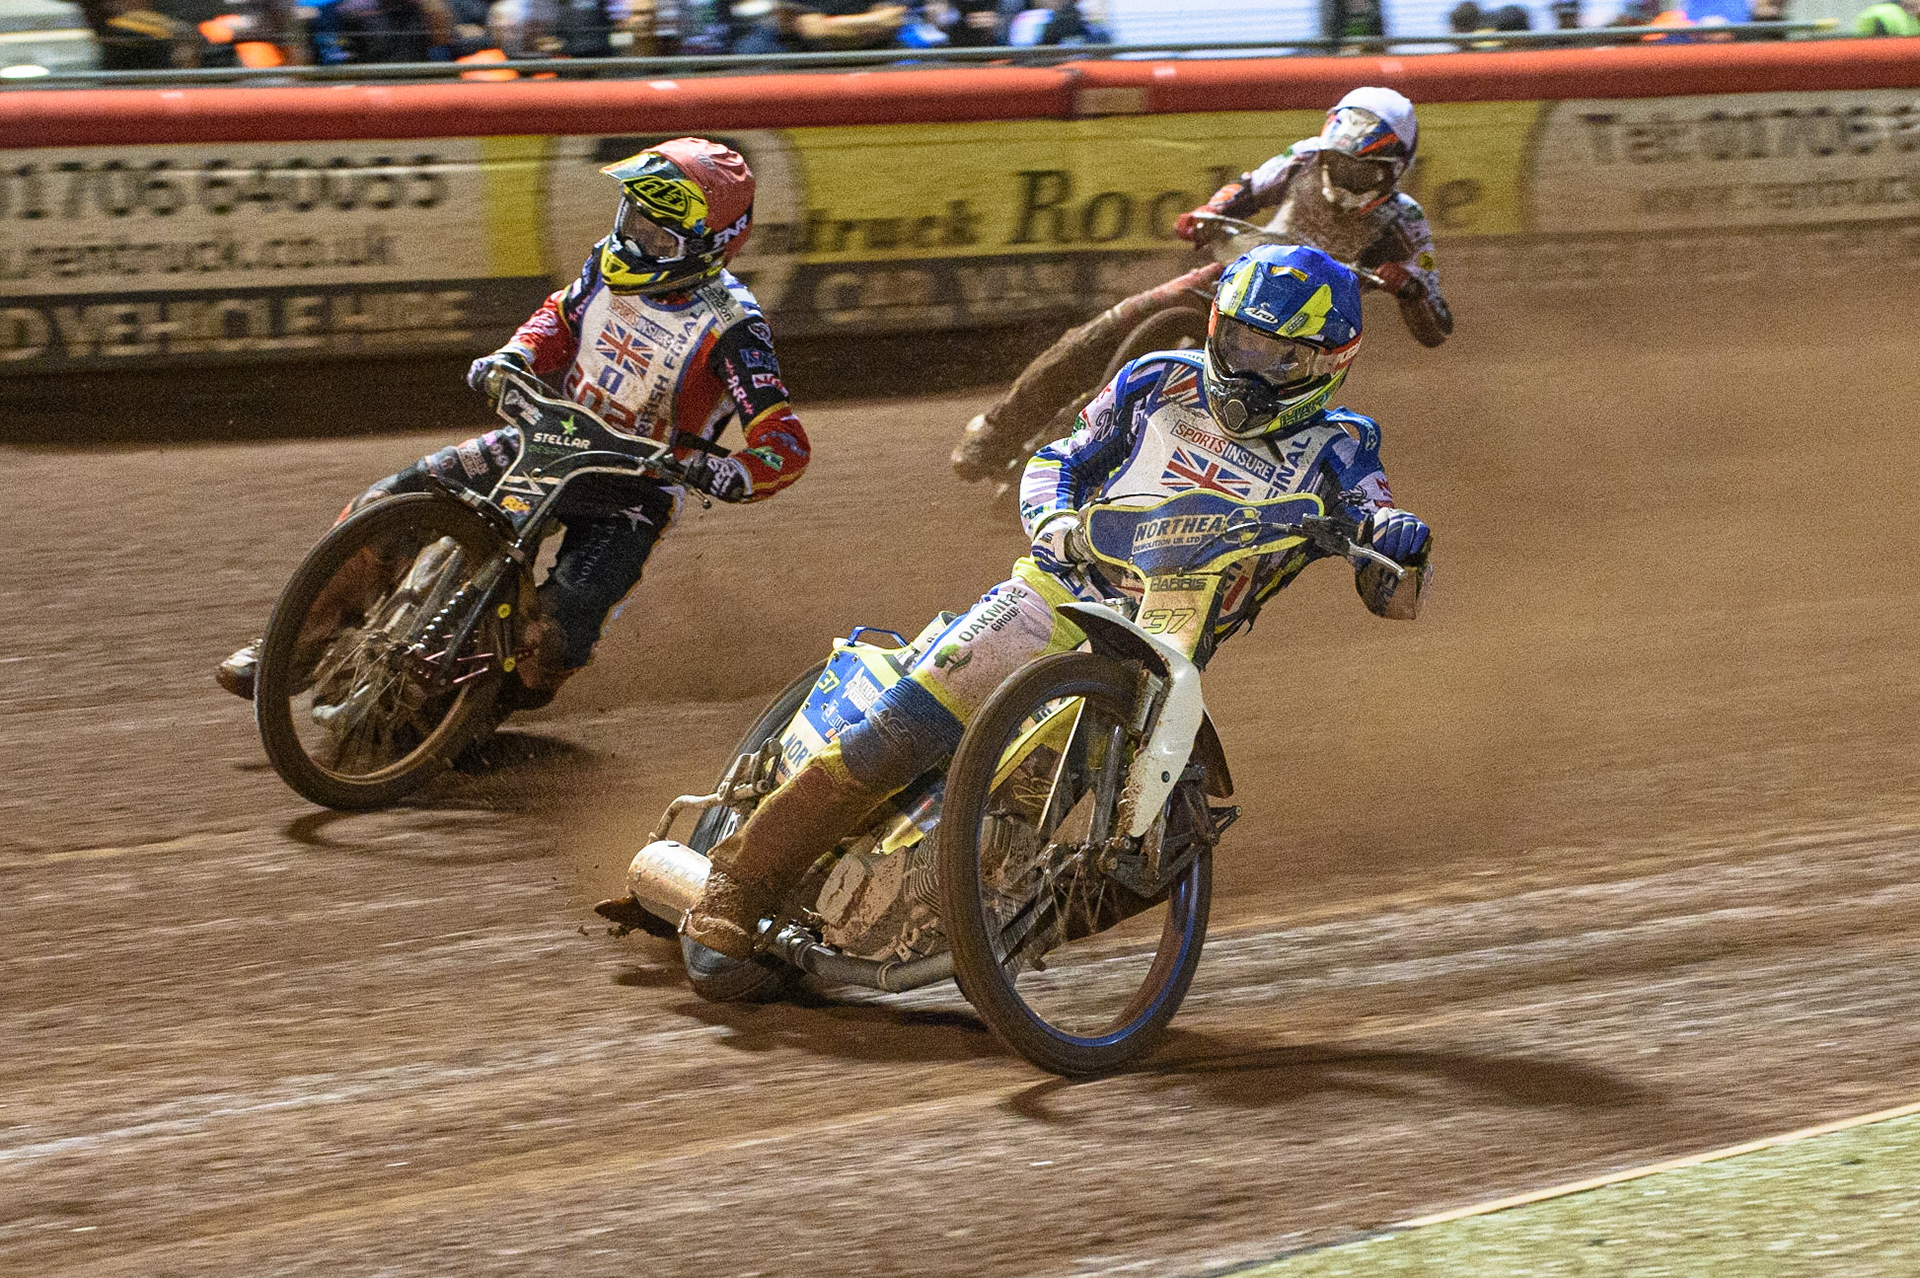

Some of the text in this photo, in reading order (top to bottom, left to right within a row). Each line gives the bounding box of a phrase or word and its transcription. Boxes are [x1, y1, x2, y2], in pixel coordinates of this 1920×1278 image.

[533, 432, 591, 450] STELLAR
[1175, 423, 1274, 480] SPORTS INSURE
[1150, 577, 1208, 592] HARRIS
[817, 668, 841, 695] 37
[783, 733, 813, 768] NOR
